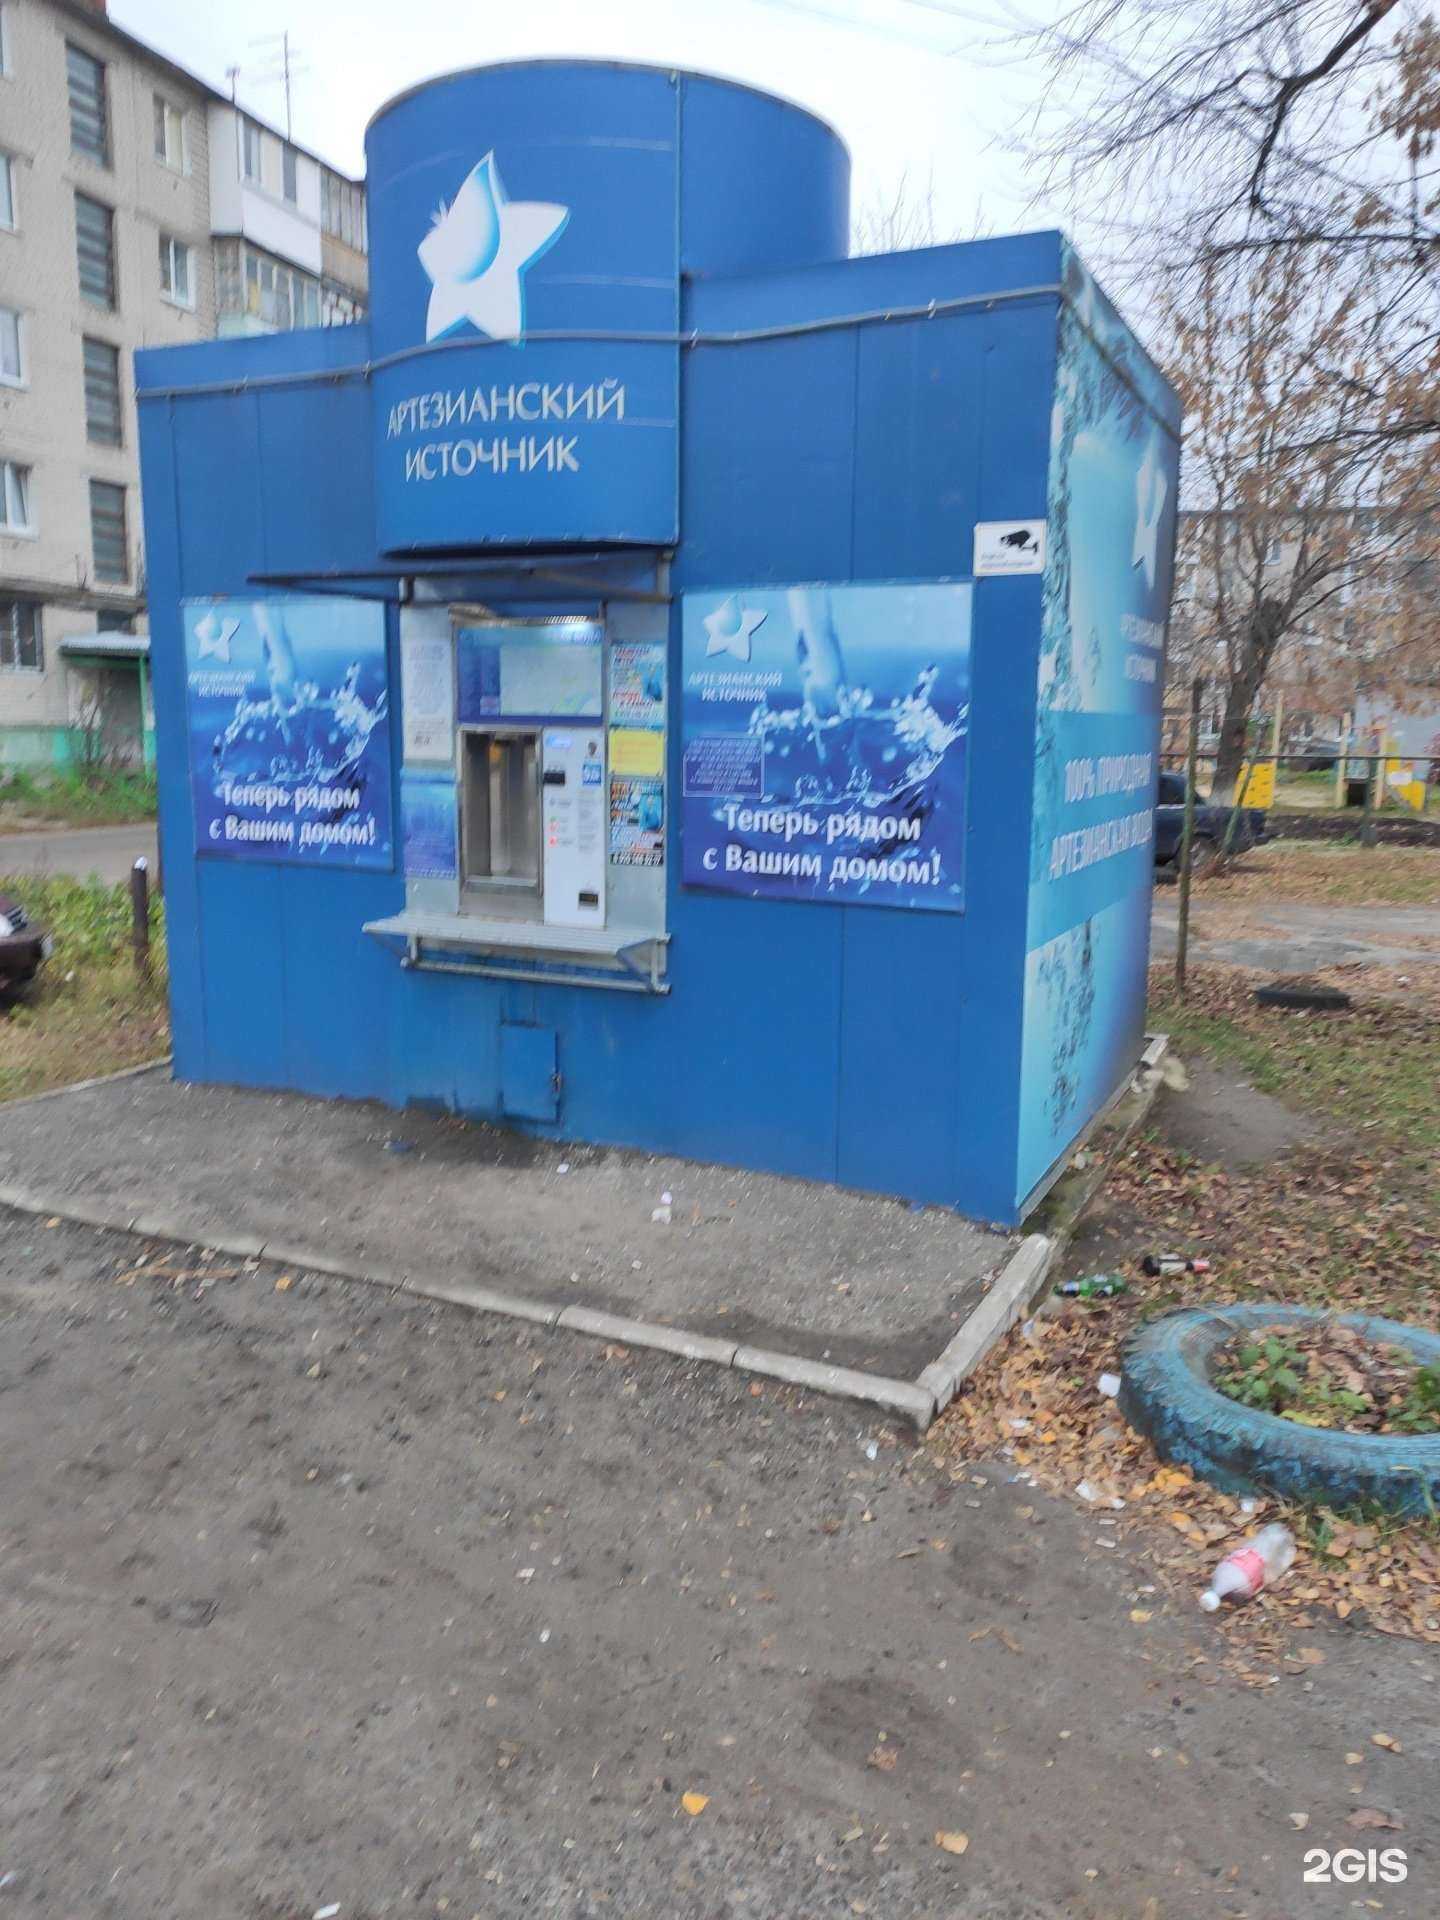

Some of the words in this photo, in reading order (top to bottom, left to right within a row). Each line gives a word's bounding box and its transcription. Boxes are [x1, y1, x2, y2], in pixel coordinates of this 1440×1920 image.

[386, 376, 626, 440] АРТЕЗИАНСКИЙ
[405, 434, 580, 482] ИСТОЧНИК
[222, 782, 291, 814] Теперь
[295, 785, 361, 815] рядом
[225, 814, 294, 843] Вашим
[299, 816, 376, 848] домом!
[723, 802, 819, 842] Теперь
[826, 813, 922, 845] рядом
[702, 847, 718, 871] с
[725, 844, 822, 876] Вашим
[829, 853, 941, 885] домом!
